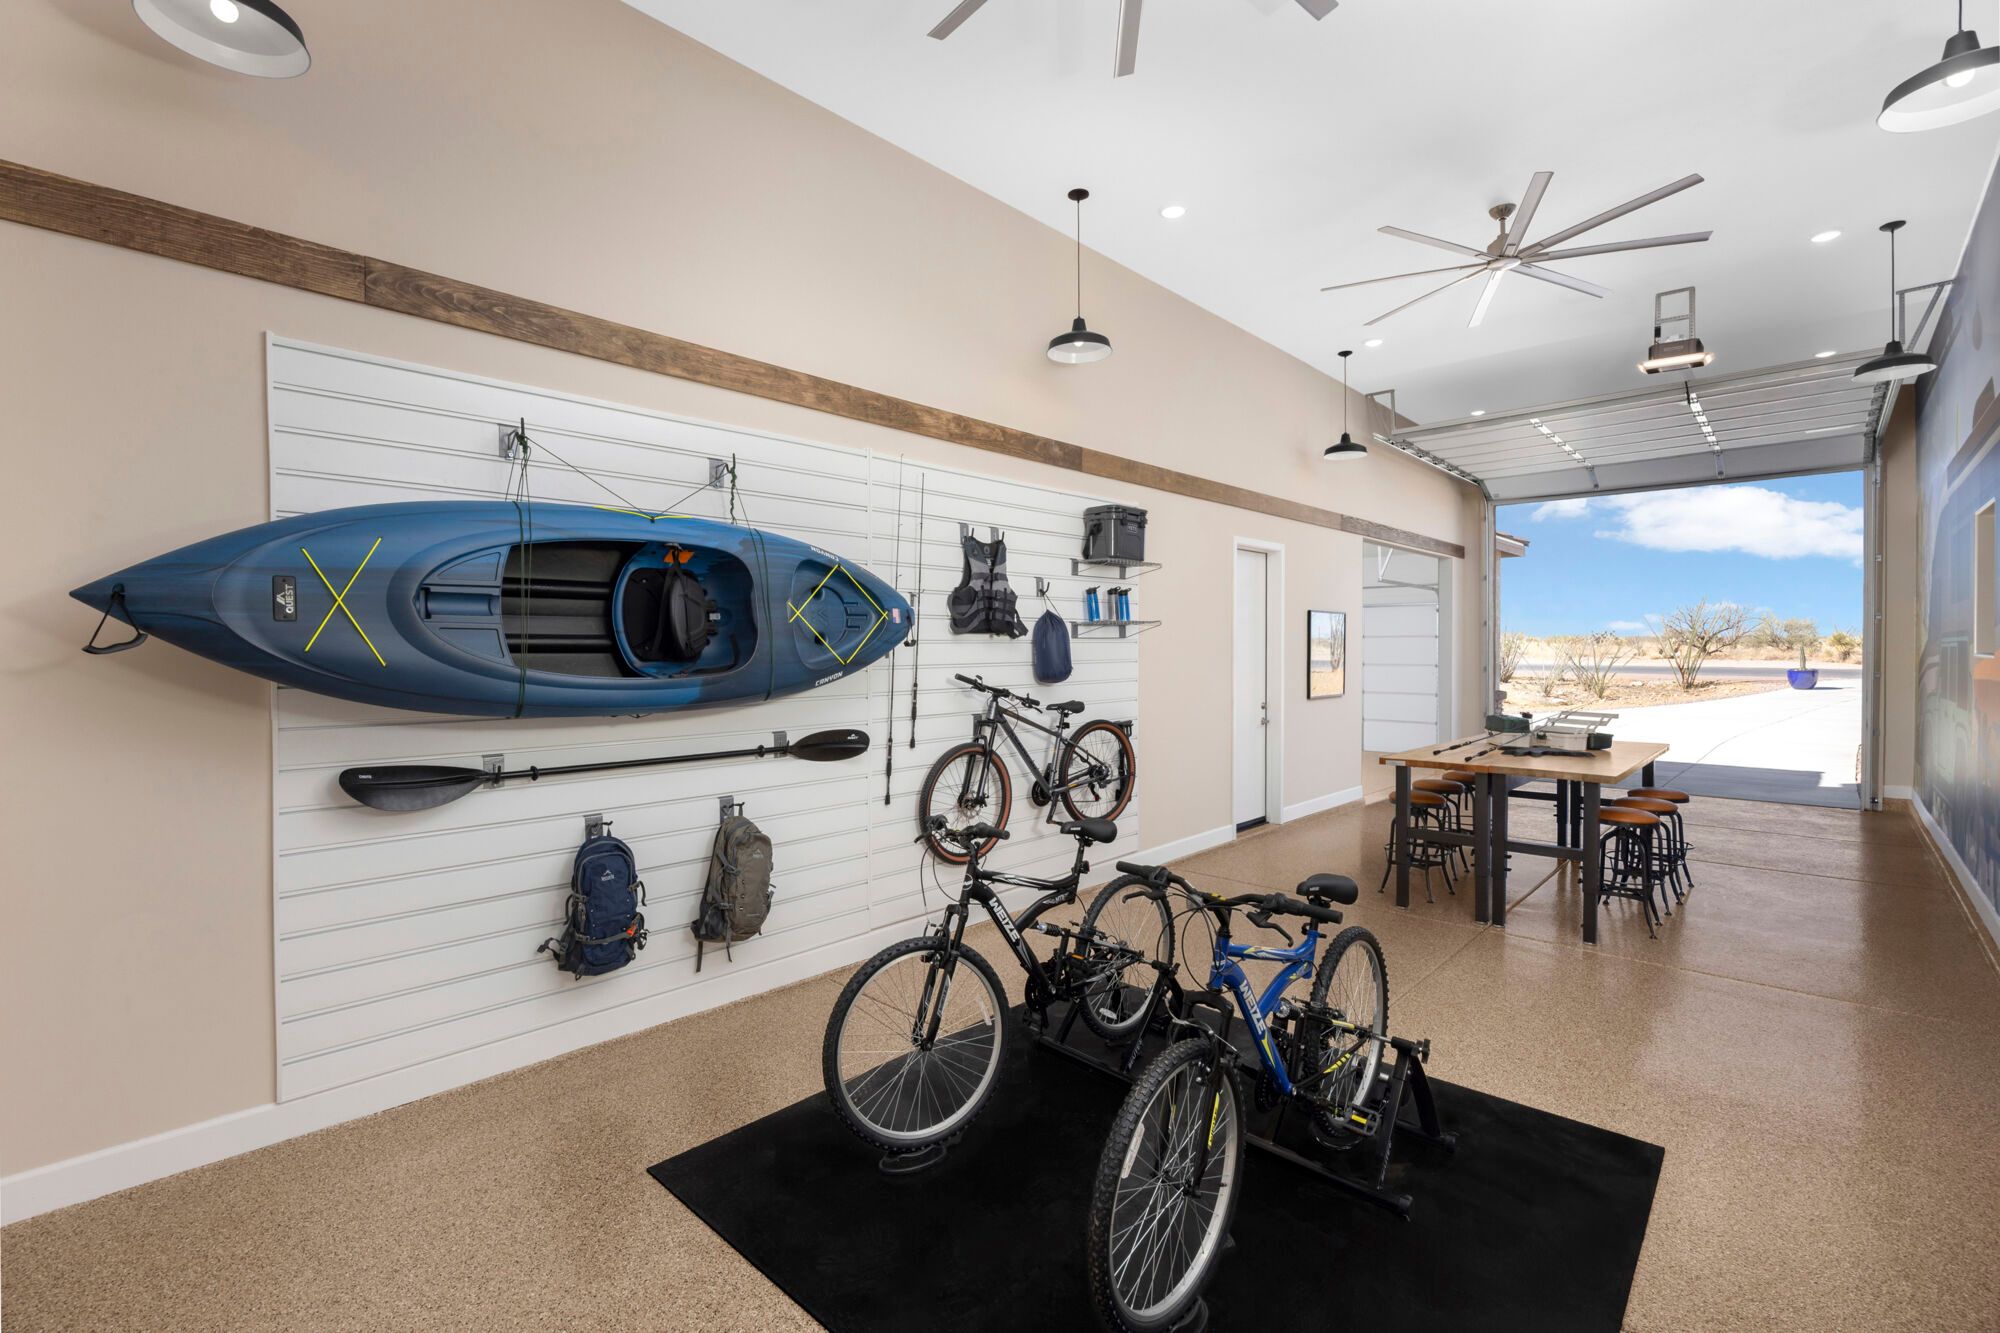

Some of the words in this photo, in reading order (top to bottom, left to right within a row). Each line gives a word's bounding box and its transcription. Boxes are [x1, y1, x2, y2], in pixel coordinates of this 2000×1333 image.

[285, 584, 294, 614] QUEST
[815, 670, 843, 687] CANYON
[988, 896, 1020, 943] WEIZE
[1239, 979, 1267, 1035] WEIZE
